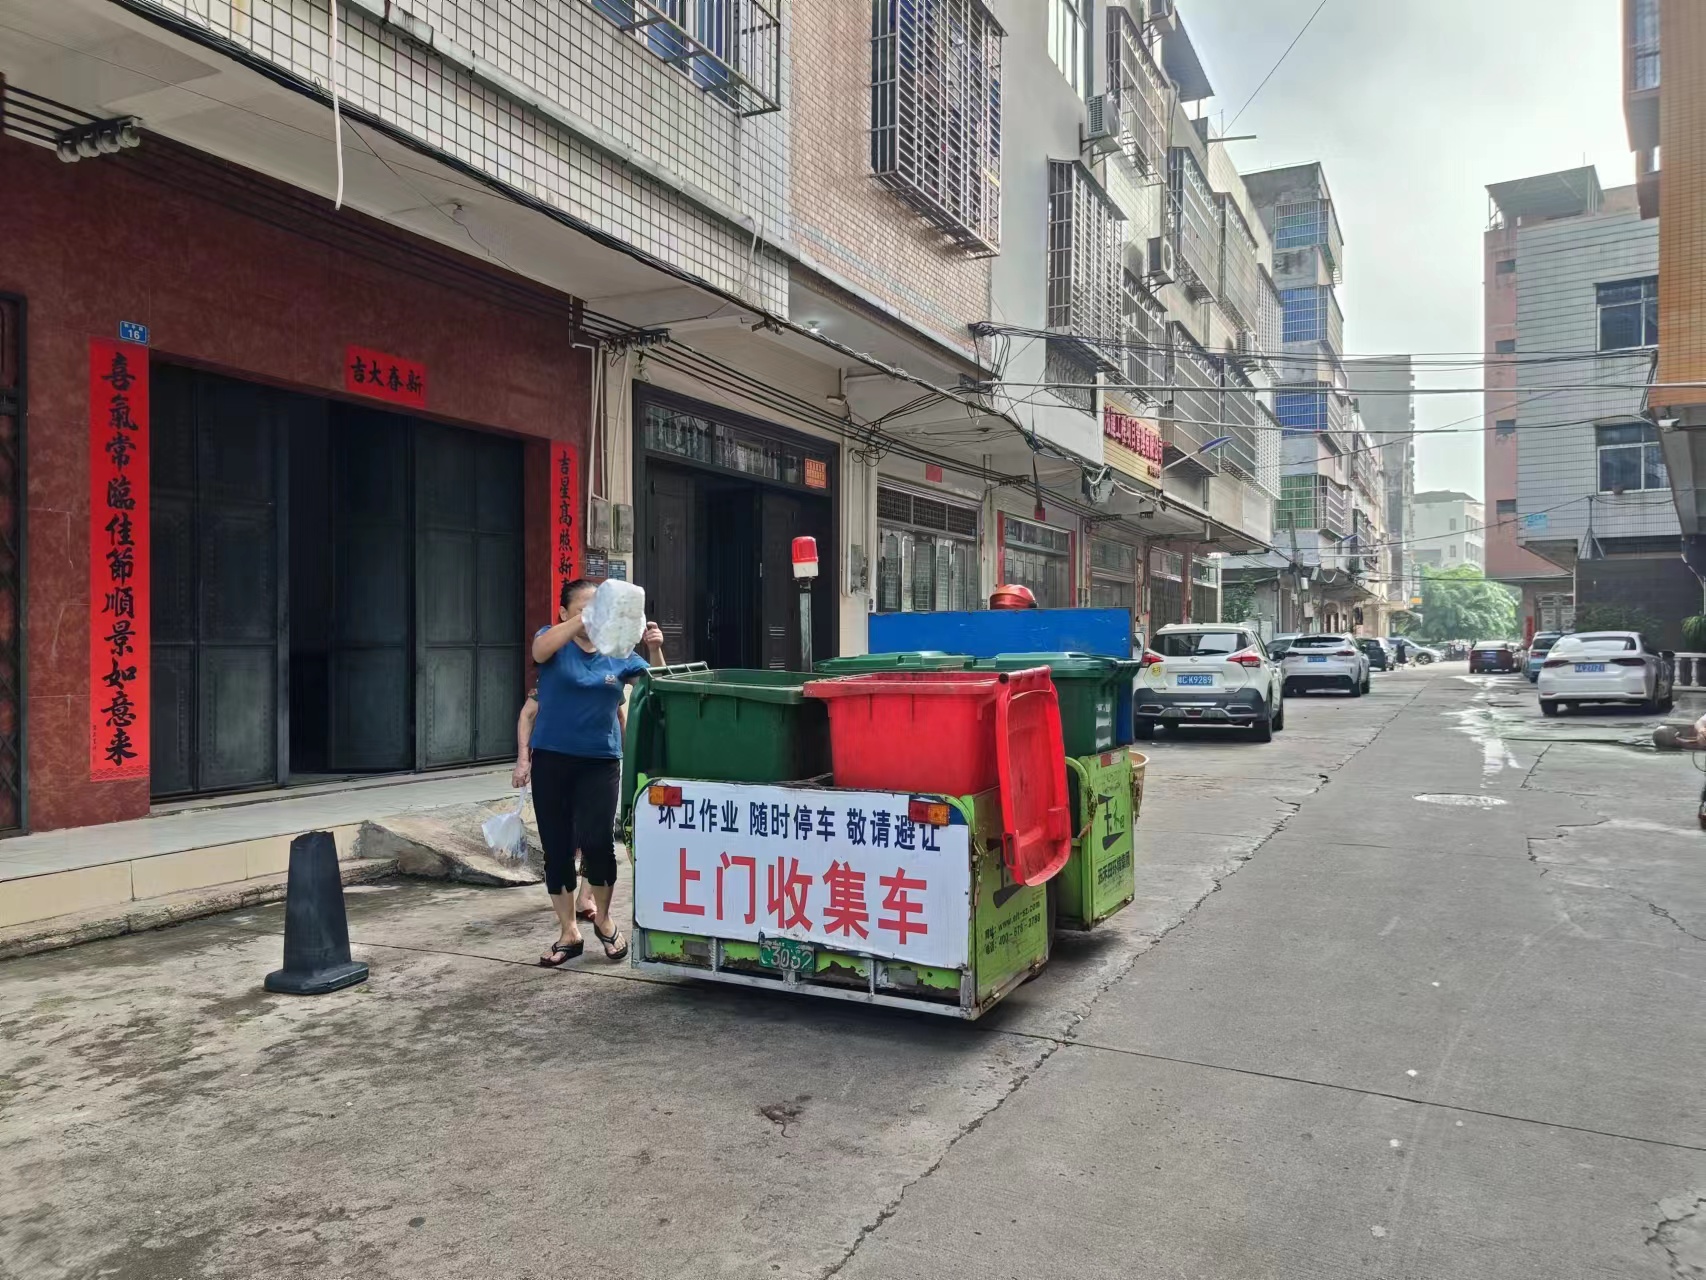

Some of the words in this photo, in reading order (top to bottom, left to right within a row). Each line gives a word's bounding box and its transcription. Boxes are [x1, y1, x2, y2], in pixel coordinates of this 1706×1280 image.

[128, 329, 140, 340] 16
[749, 801, 836, 842] 随时停车
[846, 808, 941, 852] 敬请避让
[663, 847, 928, 945] 上门收集车
